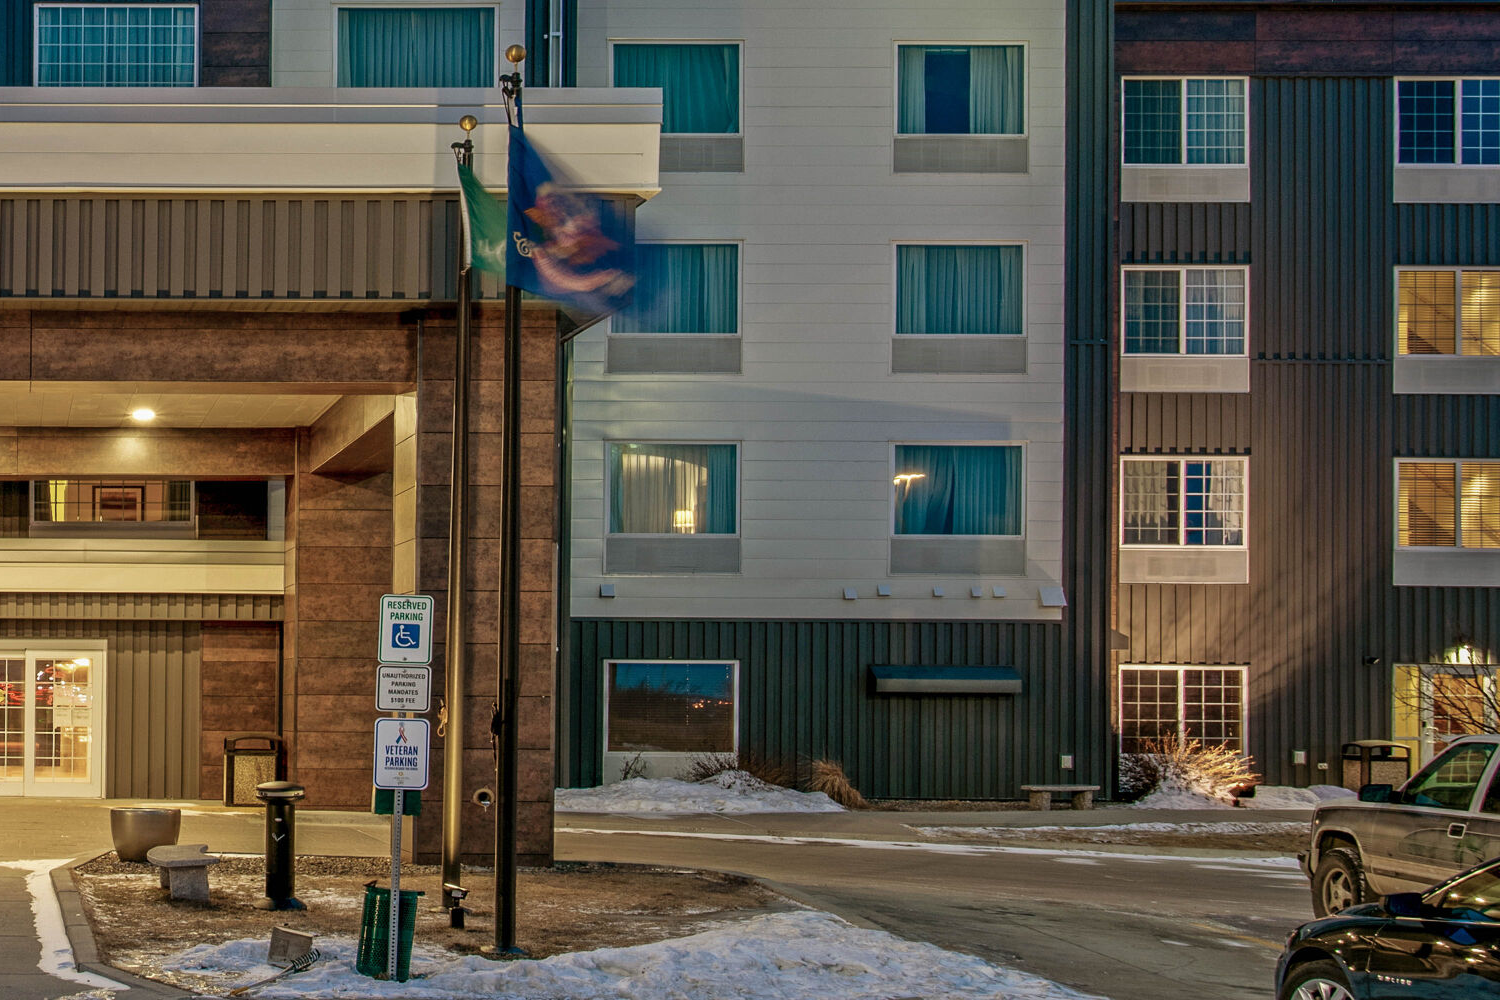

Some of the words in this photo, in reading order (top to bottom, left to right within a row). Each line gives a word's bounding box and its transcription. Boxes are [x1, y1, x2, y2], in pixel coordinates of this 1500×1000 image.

[387, 600, 427, 610] RESERVED
[390, 612, 424, 621] PARKING
[381, 672, 426, 680] UNAUTHORIZED
[385, 745, 418, 755] VETERAN
[385, 756, 418, 767] PARKING
